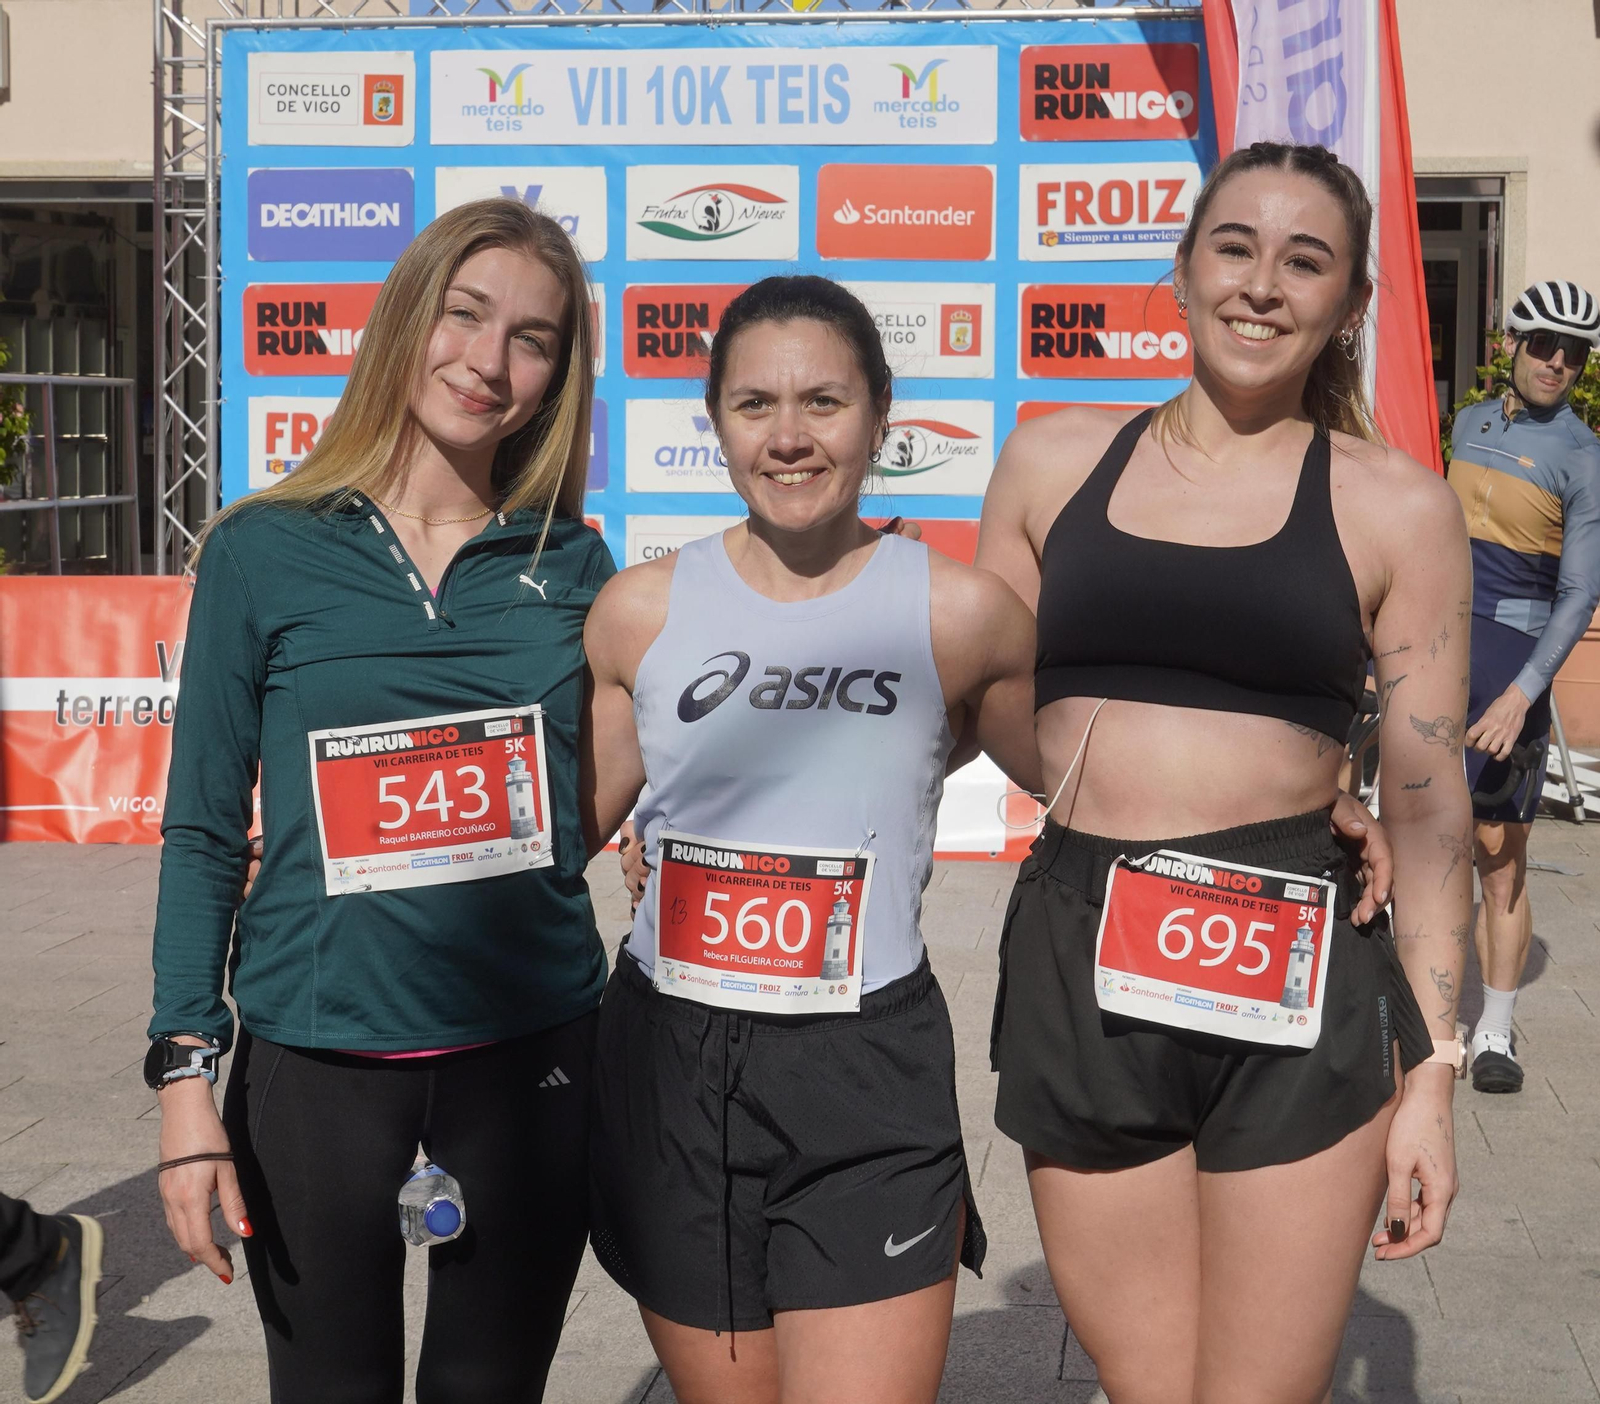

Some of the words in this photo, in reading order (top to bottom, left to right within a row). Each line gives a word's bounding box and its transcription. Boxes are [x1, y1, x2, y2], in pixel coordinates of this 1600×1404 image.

[1034, 63, 1110, 90] RUN
[267, 83, 351, 98] CONCELLO
[567, 67, 627, 126] VII
[646, 65, 732, 126] 10K
[747, 63, 851, 126] TEIS
[277, 101, 297, 113] DE
[304, 101, 341, 113] VIGO
[462, 98, 544, 117] mercado
[873, 96, 960, 114] mercado
[486, 116, 523, 131] teis
[898, 112, 937, 129] teis
[1037, 179, 1187, 226] FROIZ
[260, 202, 400, 228] DECATHLON
[641, 205, 689, 220] Frutas
[738, 205, 786, 220] Nieves
[864, 204, 975, 227] Santander
[1064, 232, 1111, 243] Siempre
[1122, 233, 1135, 241] su
[1138, 231, 1182, 241] servicio
[257, 302, 326, 327] RUN
[637, 303, 709, 329] RUN
[1031, 303, 1105, 329] RUN
[266, 412, 334, 455] FR
[931, 440, 979, 457] Nieves
[505, 737, 526, 754] 5K
[373, 757, 388, 769] VII
[390, 750, 443, 767] CARREIRA
[445, 749, 460, 760] DE
[462, 746, 484, 758] TEIS
[378, 765, 491, 830] 543
[379, 834, 408, 847] Raquel
[410, 829, 451, 842] BARREIRO
[452, 823, 496, 836] COUÑAGO
[451, 852, 474, 862] FROIZ
[478, 852, 502, 862] amura
[367, 862, 410, 874] Santander
[705, 872, 717, 882] VII
[719, 875, 770, 889] CARREIRA
[772, 880, 787, 890] DE
[789, 881, 812, 892] TEIS
[833, 880, 853, 895] 5K
[1170, 884, 1184, 896] VII
[1186, 888, 1238, 906] CARREIRA
[1241, 898, 1256, 909] DE
[1258, 901, 1279, 913] TEIS
[701, 890, 812, 954] 560
[1297, 906, 1317, 922] 5K
[1157, 907, 1275, 976] 695
[703, 950, 729, 962] Rebeca
[730, 954, 771, 966] FILGUEIRA
[773, 959, 803, 969] CONDE
[687, 973, 719, 988] Santander
[759, 983, 781, 993] FROIZ
[784, 989, 809, 997] amura
[1131, 985, 1173, 1002] Santander
[1215, 1002, 1238, 1014] FROIZ
[1241, 1011, 1267, 1021] amura
[1378, 996, 1388, 1027] GYM
[1381, 1029, 1389, 1078] MINUTE
